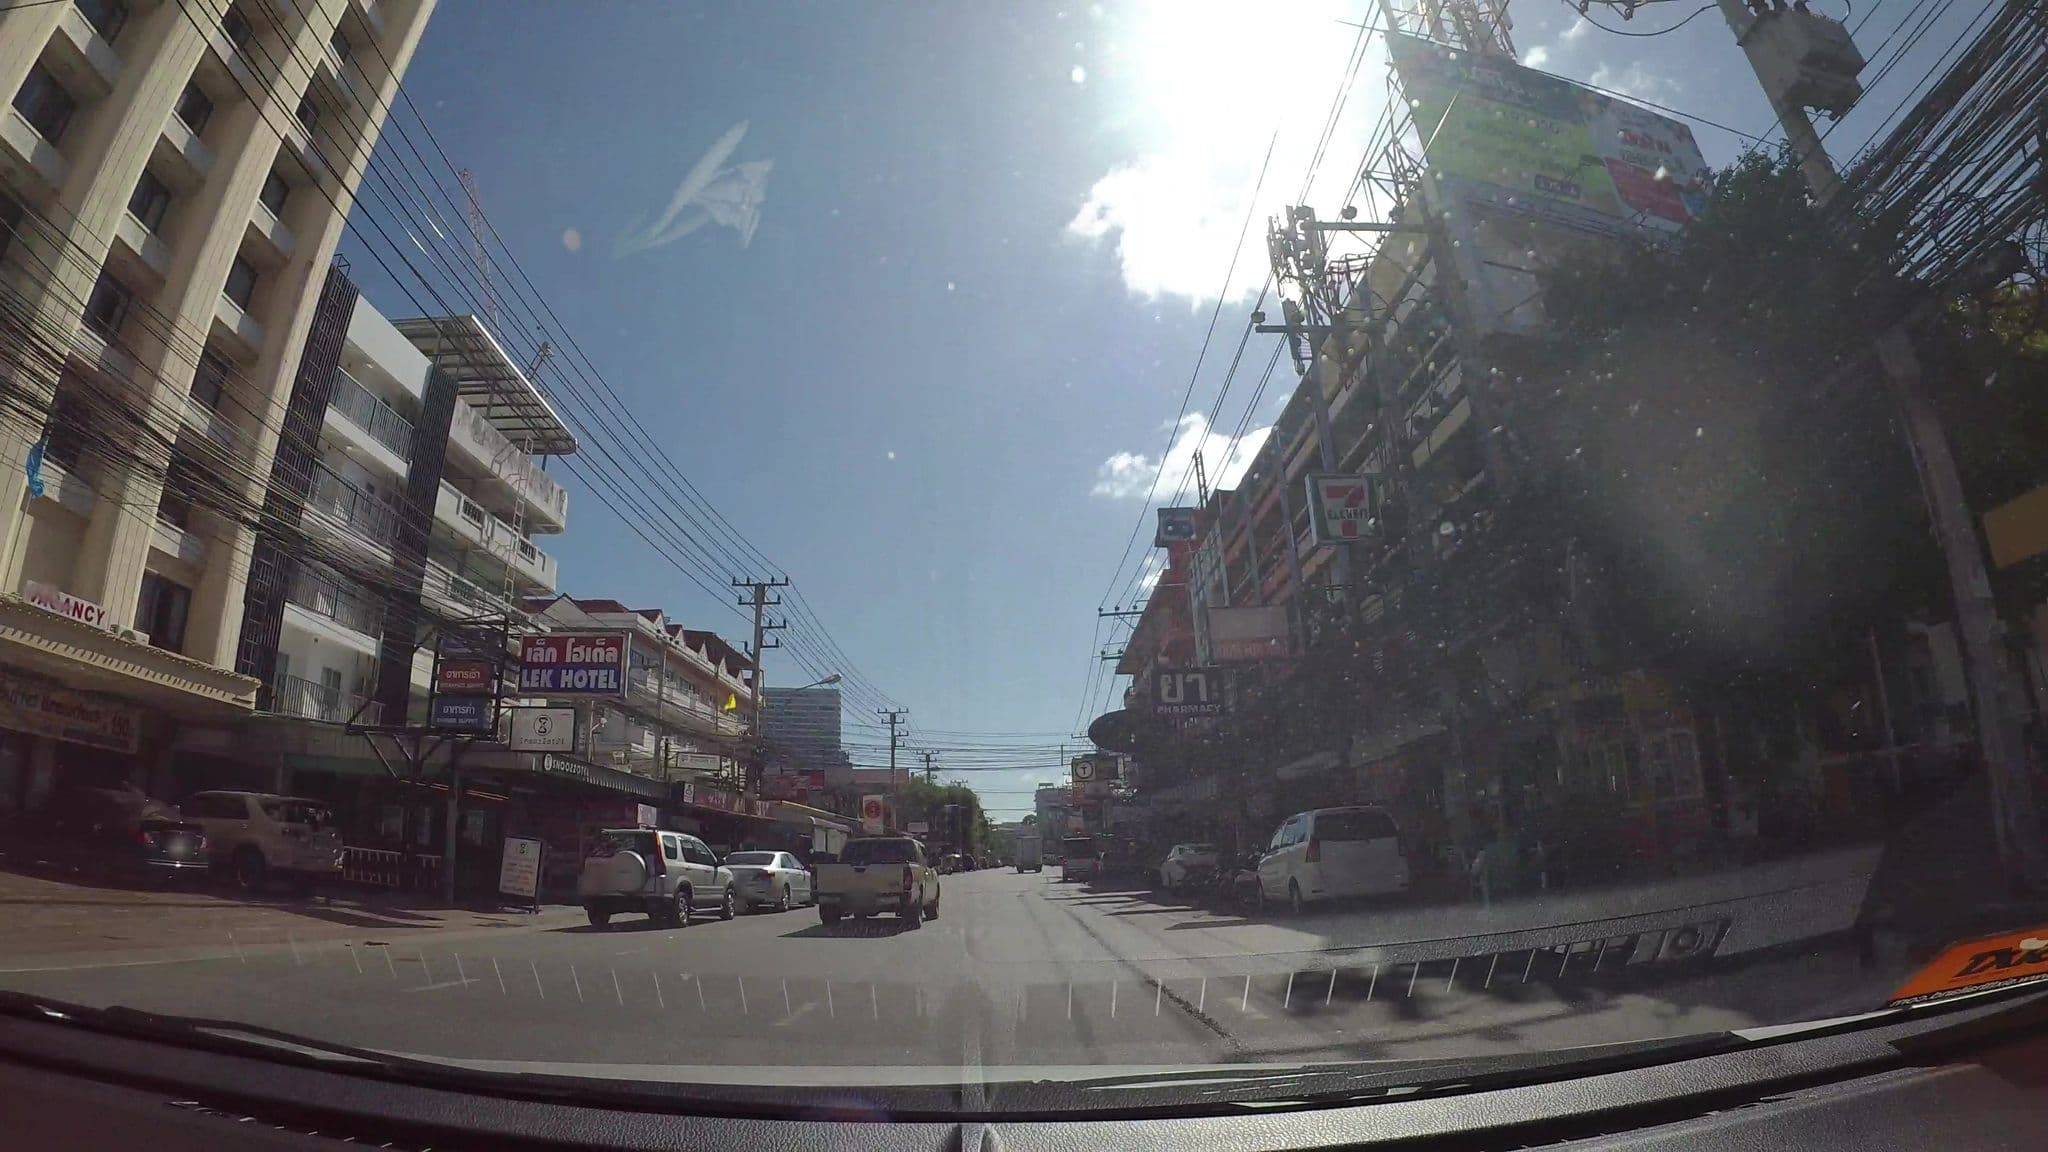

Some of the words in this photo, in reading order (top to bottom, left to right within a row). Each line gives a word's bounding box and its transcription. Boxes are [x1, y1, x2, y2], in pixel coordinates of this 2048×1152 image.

[521, 668, 552, 688] LEK
[560, 668, 618, 689] HOTEL
[1157, 704, 1221, 714] PHARMACY
